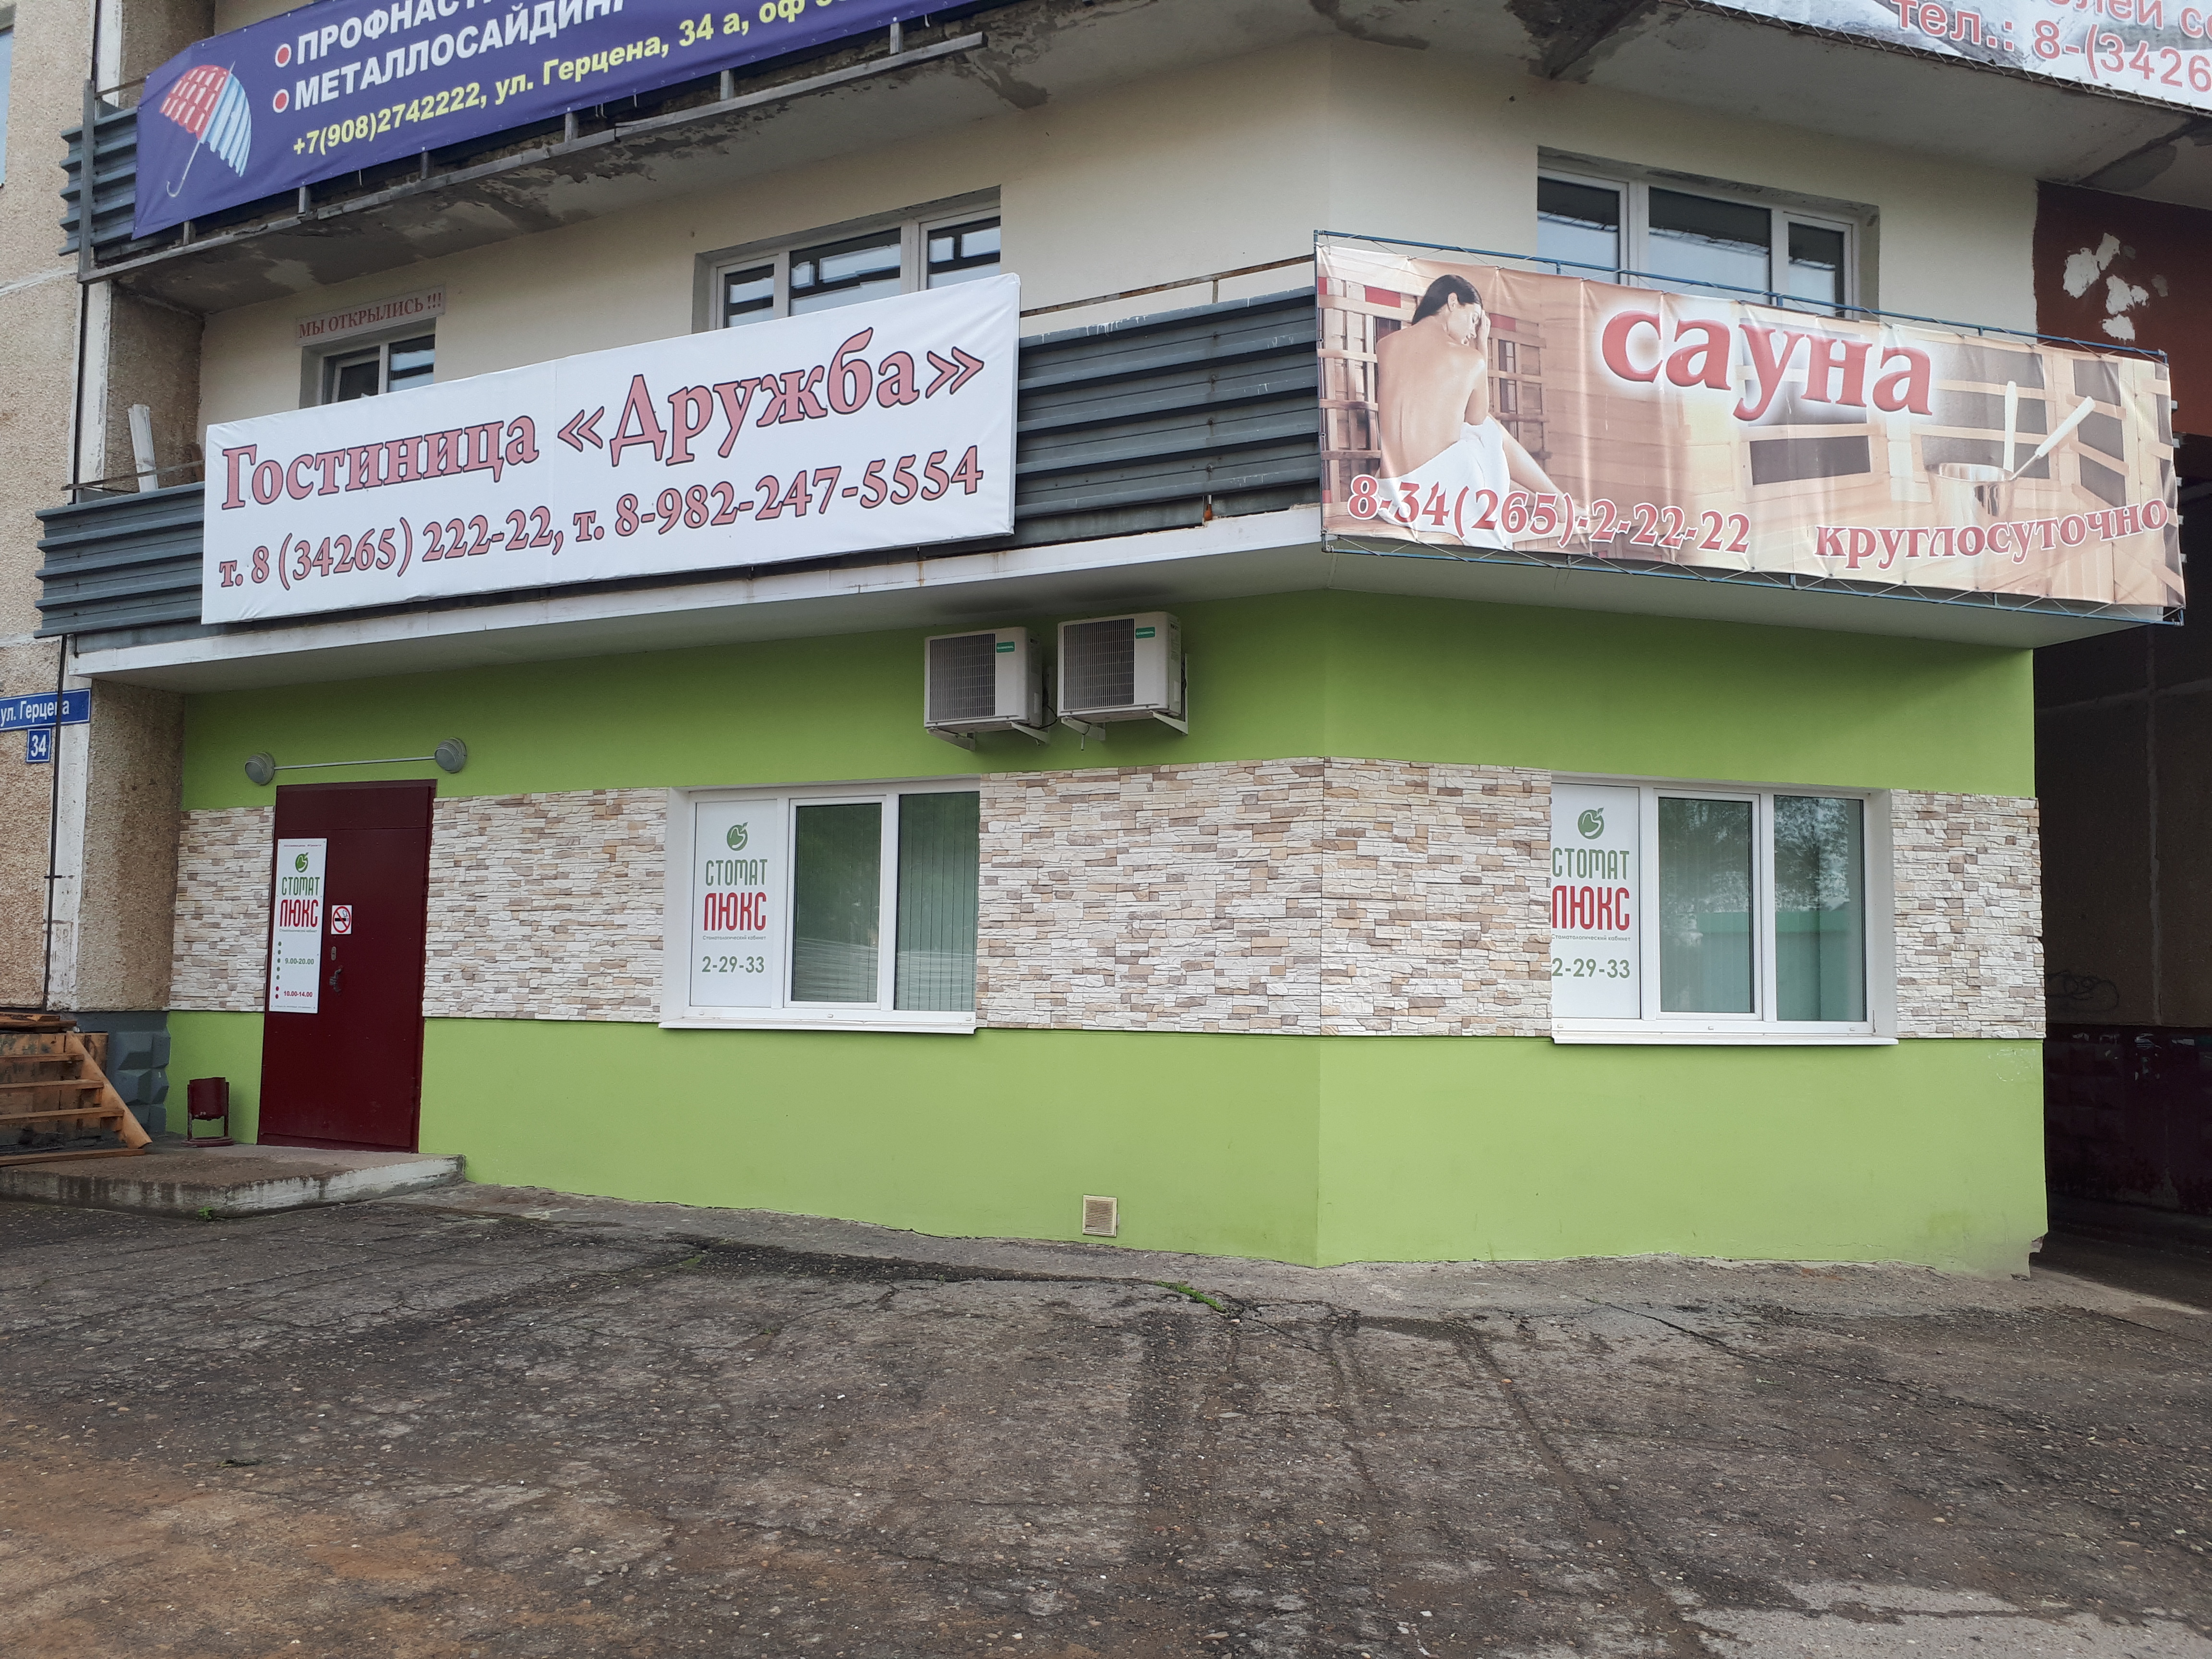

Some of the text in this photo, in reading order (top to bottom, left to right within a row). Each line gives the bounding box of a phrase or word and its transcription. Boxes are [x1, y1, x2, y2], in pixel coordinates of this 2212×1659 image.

[297, 0, 492, 65] ПРОФНАС
[1892, 0, 2014, 50] тел.:
[293, 82, 487, 156] +7(908)2742222,
[495, 74, 534, 105] ул.
[543, 36, 669, 85] Герцена,
[679, 13, 714, 47] 34
[723, 12, 749, 36] а,
[299, 292, 442, 338] МЫ ОТКРЫЛИСЬ !!!
[1601, 310, 1933, 421] сауна
[222, 327, 985, 510] Гостиница «Дружба»
[219, 445, 984, 590] т. 8 (34265) 222-22, т. 8-982-247-5554
[1348, 475, 1751, 554] 8-34(265)-2-22-22
[1815, 499, 2168, 570] круглосуточно
[0, 707, 16, 727] ул.
[30, 734, 47, 757] 34
[281, 877, 320, 896] СТОМАТ
[705, 859, 768, 886] СТОМАТ
[1552, 847, 1629, 880] СТОМАТ
[279, 899, 318, 927] ЛЮКС
[704, 892, 767, 931] ЛЮКС
[1552, 885, 1630, 931] ЛЮКС
[701, 956, 765, 974] 2-29-33
[1551, 958, 1630, 979] 2-29-33
